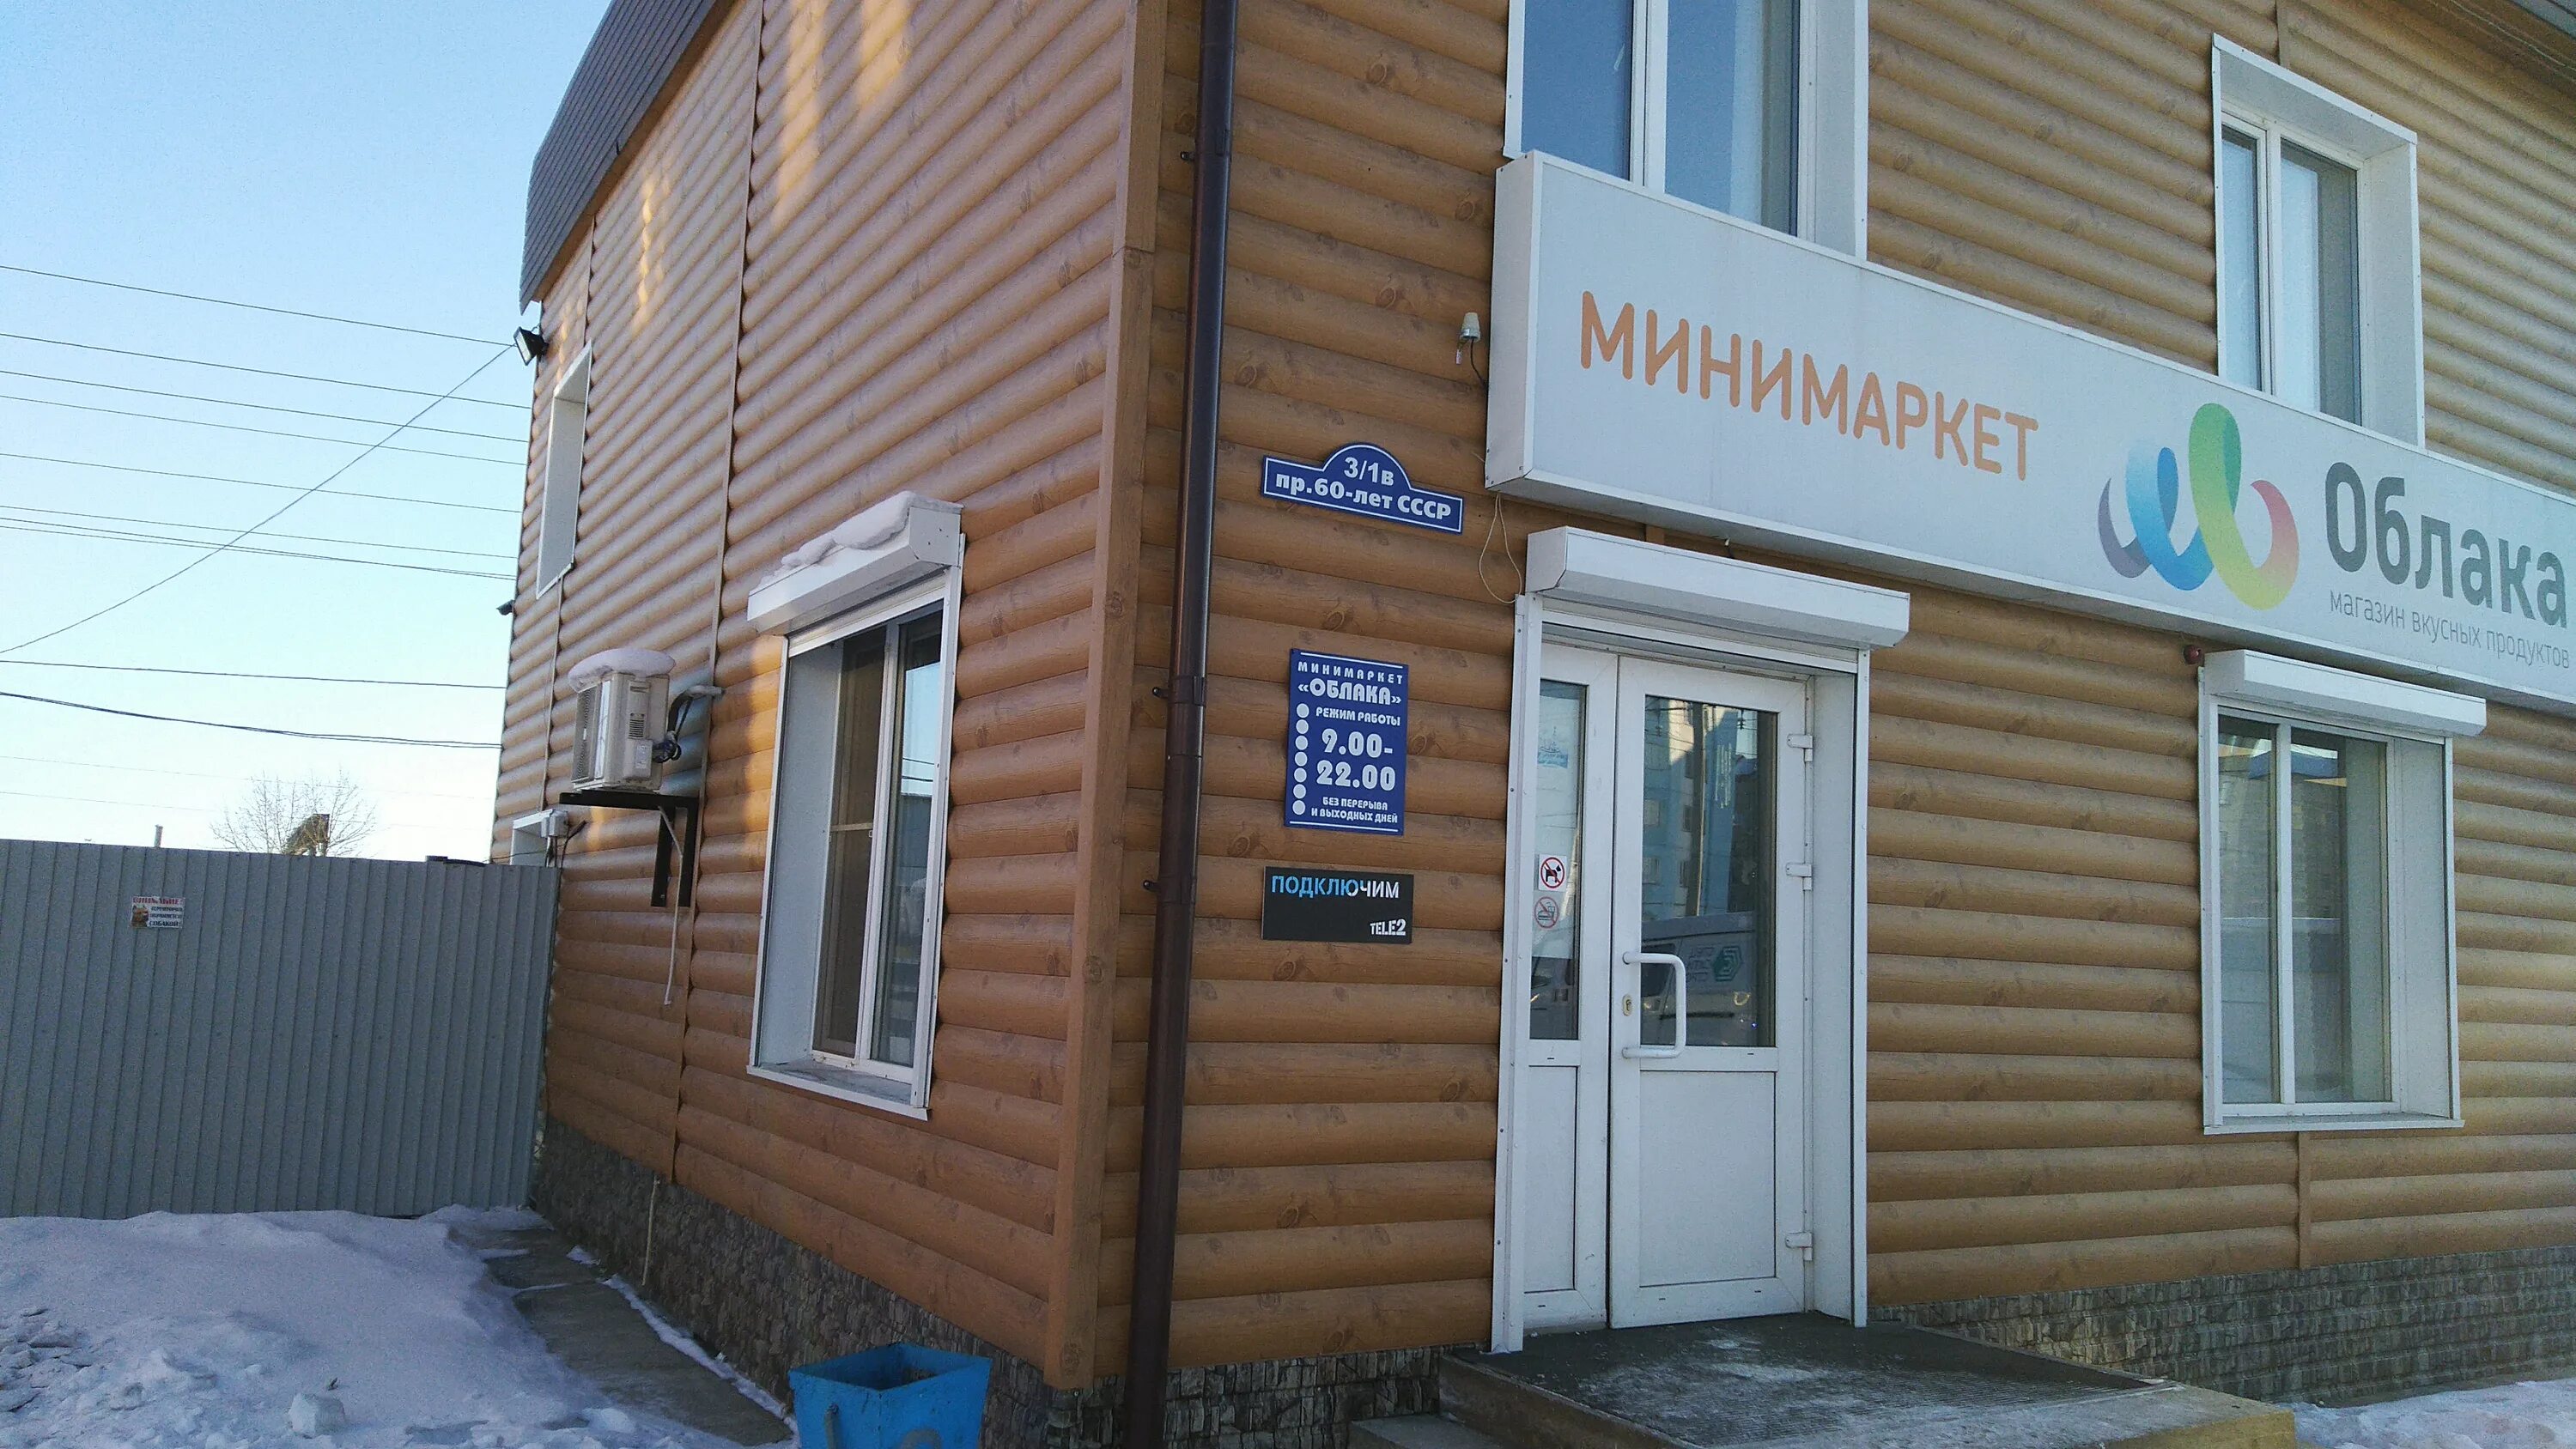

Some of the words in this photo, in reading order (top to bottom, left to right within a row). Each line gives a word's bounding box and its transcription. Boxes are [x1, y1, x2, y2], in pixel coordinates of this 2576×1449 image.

[1581, 291, 2038, 481] МИНИМАРКЕТ
[1397, 495, 1451, 519] СССР
[2324, 461, 2567, 628] Облака
[2330, 591, 2405, 629] магазин
[2412, 611, 2482, 648] вкусных
[2487, 630, 2570, 669] продуктов
[1297, 661, 1403, 685] МИНИМАРКЕТ
[1297, 677, 1401, 706] «ОБЛАКА»
[1315, 706, 1356, 721] РЕЖИМ
[1358, 710, 1400, 726] РАБОТЫ
[1316, 760, 1396, 791] 22.00
[1311, 808, 1318, 816] И
[1320, 808, 1373, 822] ВЫХОДНЫХ
[1375, 812, 1398, 823] ДНЕЙ
[1322, 797, 1340, 806] БЕЗ
[1340, 798, 1388, 811] ПЕРЕРЫВА
[1271, 876, 1400, 899] ПОДКЛЮЧИМ
[1370, 919, 1406, 936] TELE2
